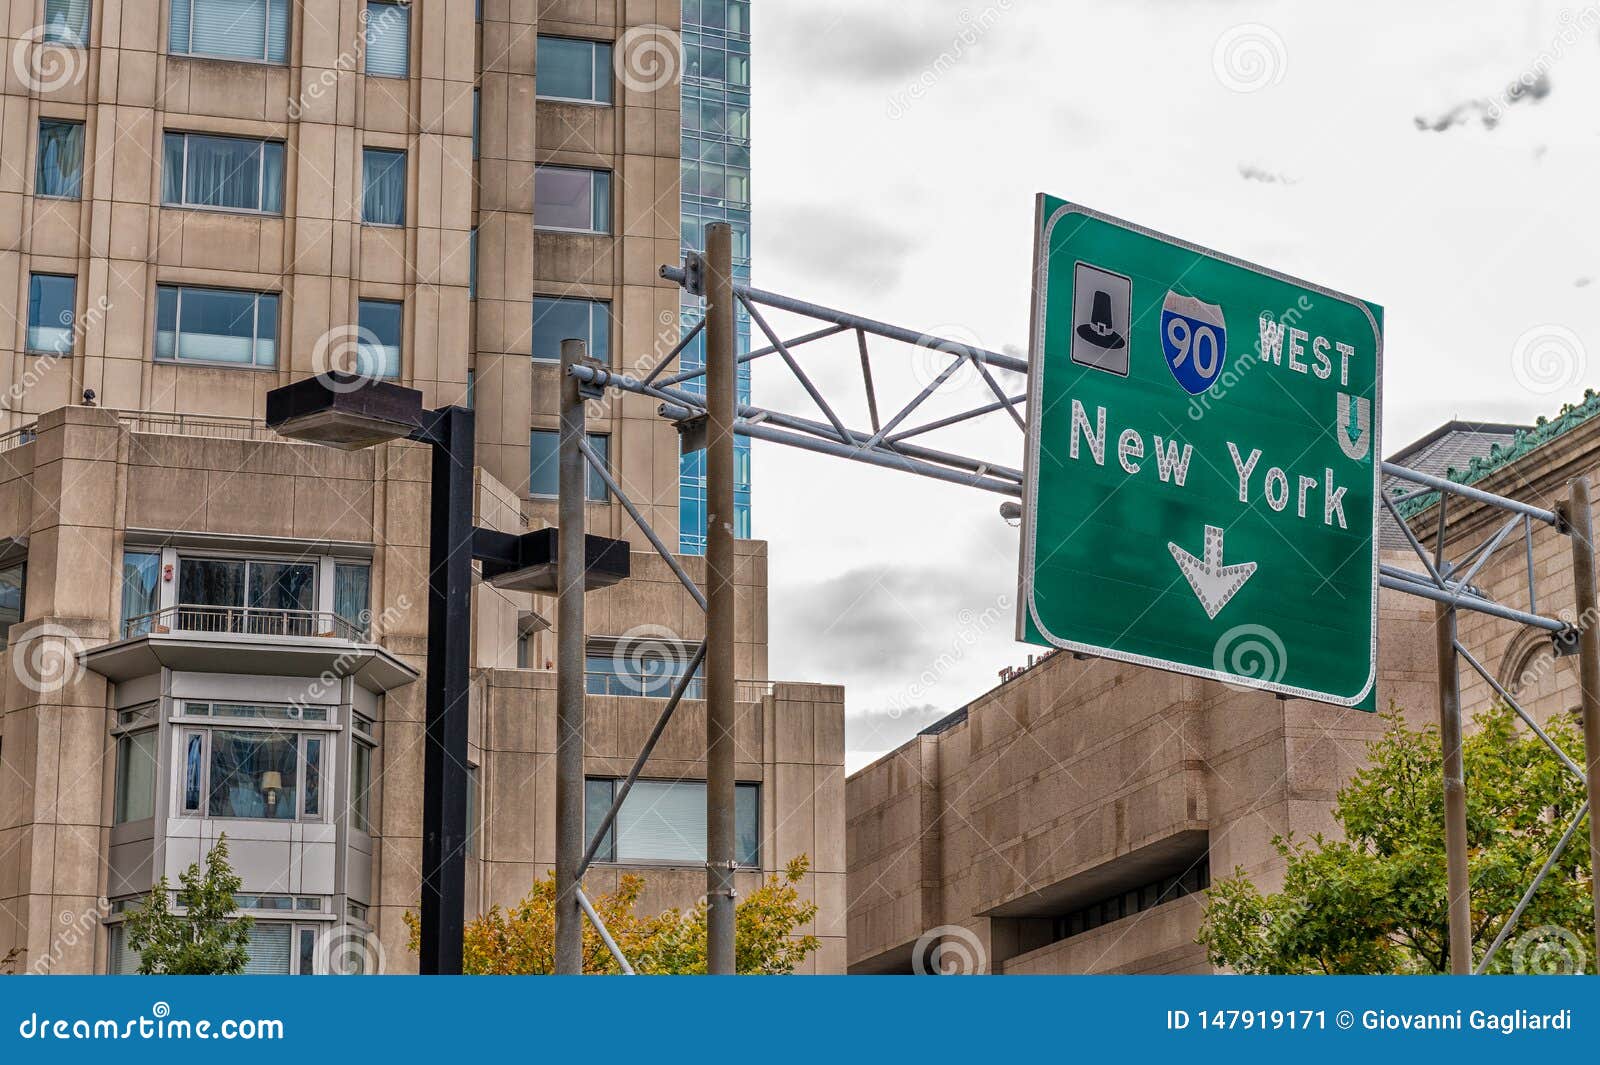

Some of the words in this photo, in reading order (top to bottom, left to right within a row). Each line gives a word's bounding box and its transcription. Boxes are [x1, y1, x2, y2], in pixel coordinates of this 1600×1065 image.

[1167, 317, 1219, 378] 90
[1259, 317, 1355, 386] WEST
[1070, 399, 1193, 487] New
[1226, 441, 1348, 529] York
